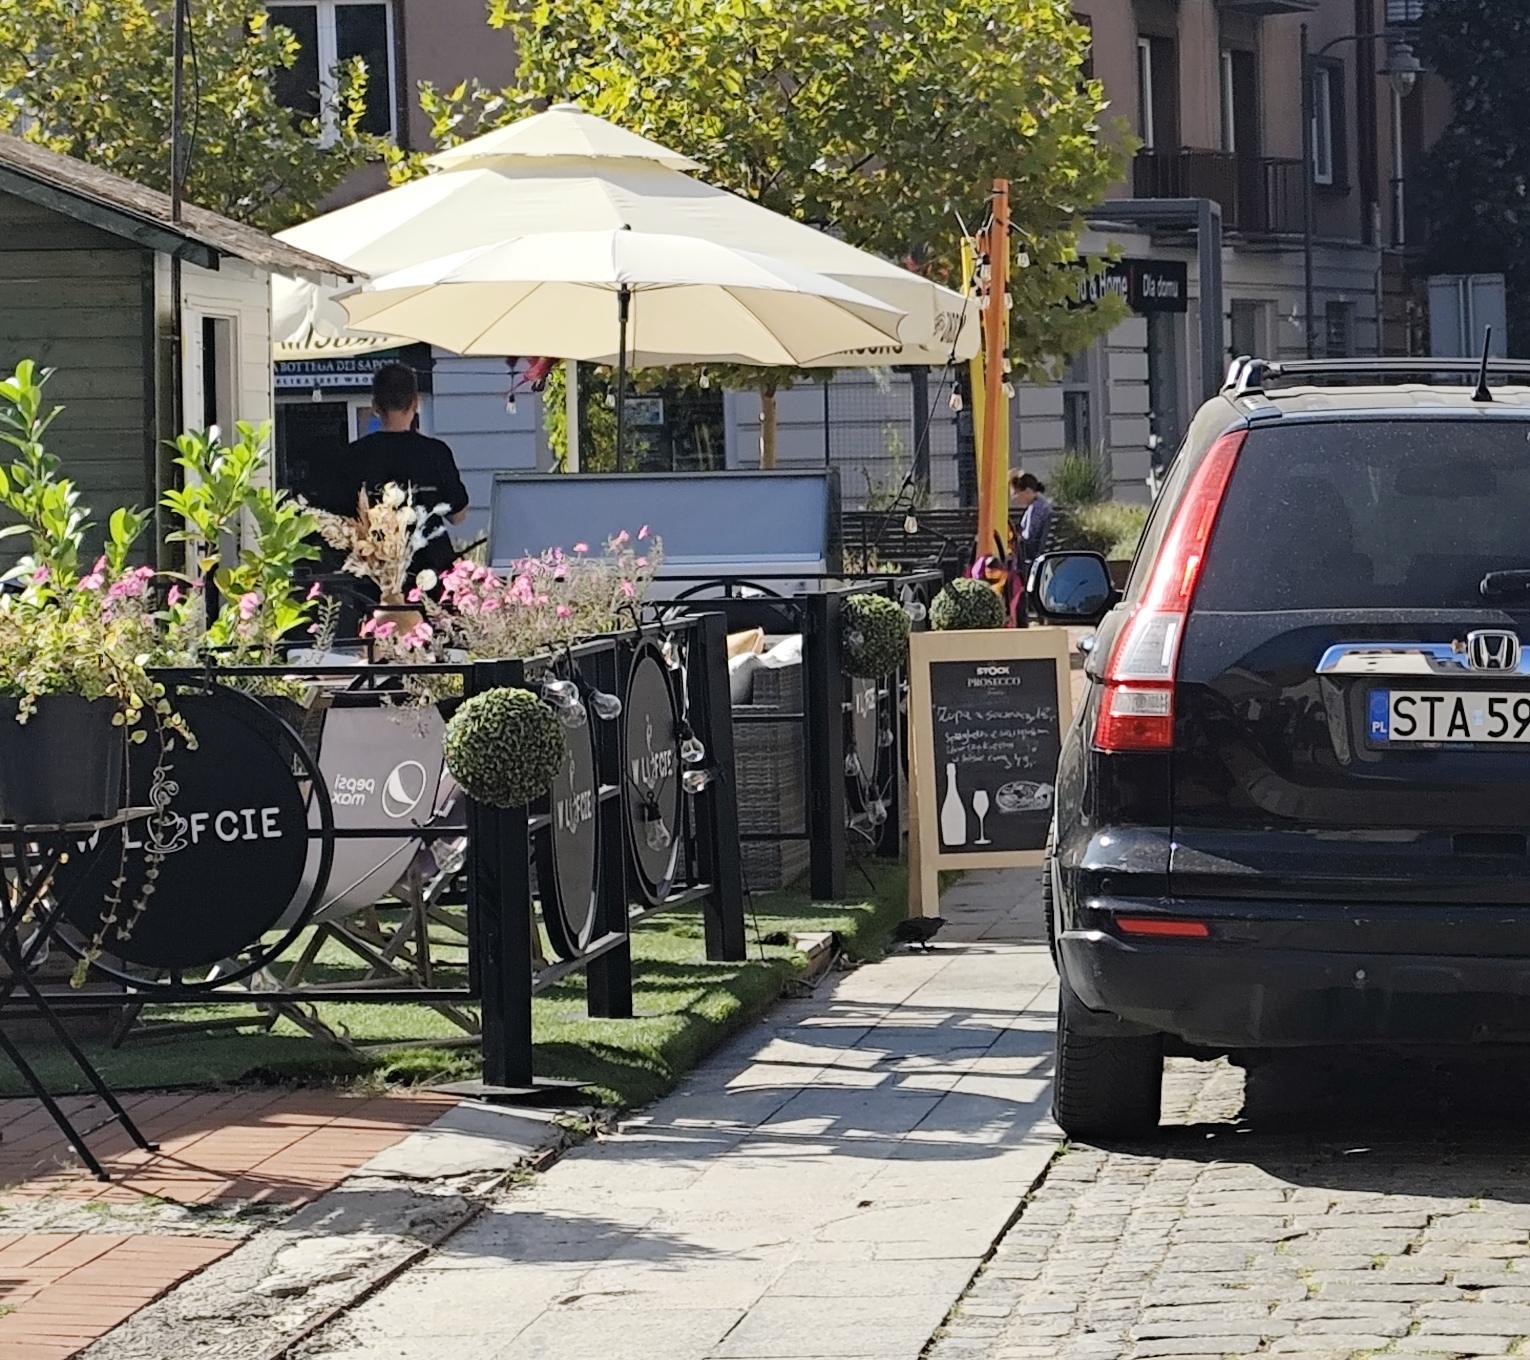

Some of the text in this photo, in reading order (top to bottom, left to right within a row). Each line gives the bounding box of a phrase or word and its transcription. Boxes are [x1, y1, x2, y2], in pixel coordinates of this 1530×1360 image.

[1142, 274, 1178, 298] Dla domu
[280, 361, 334, 372] BOTTEGA
[977, 666, 1010, 675] STOCK
[968, 676, 1021, 687] PROSECCO
[1372, 721, 1388, 734] PL
[1393, 696, 1471, 738] STA
